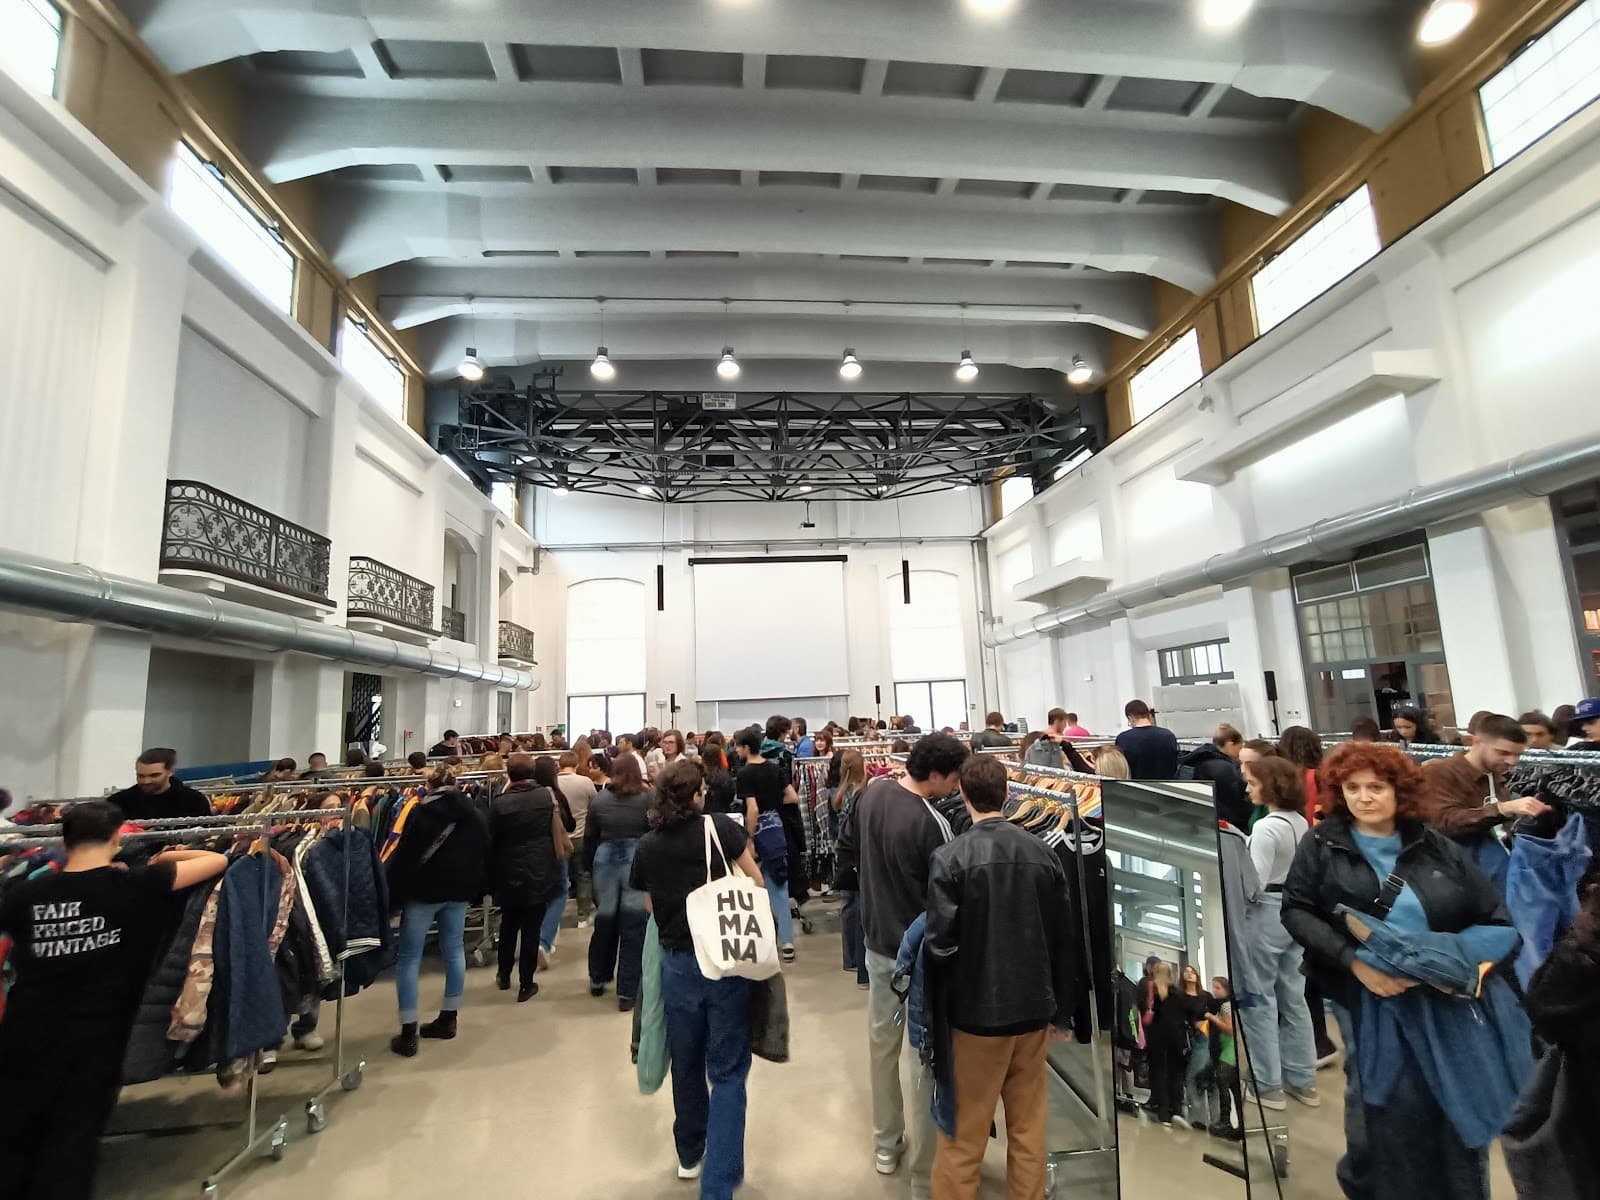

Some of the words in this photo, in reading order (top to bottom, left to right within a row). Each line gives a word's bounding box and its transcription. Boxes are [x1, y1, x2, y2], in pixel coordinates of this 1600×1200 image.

[33, 901, 82, 921] FAIR
[717, 889, 755, 912] HU
[33, 916, 106, 939] PRICED
[719, 914, 763, 938] MA
[32, 928, 122, 958] VINTAGE
[721, 938, 758, 964] NA
